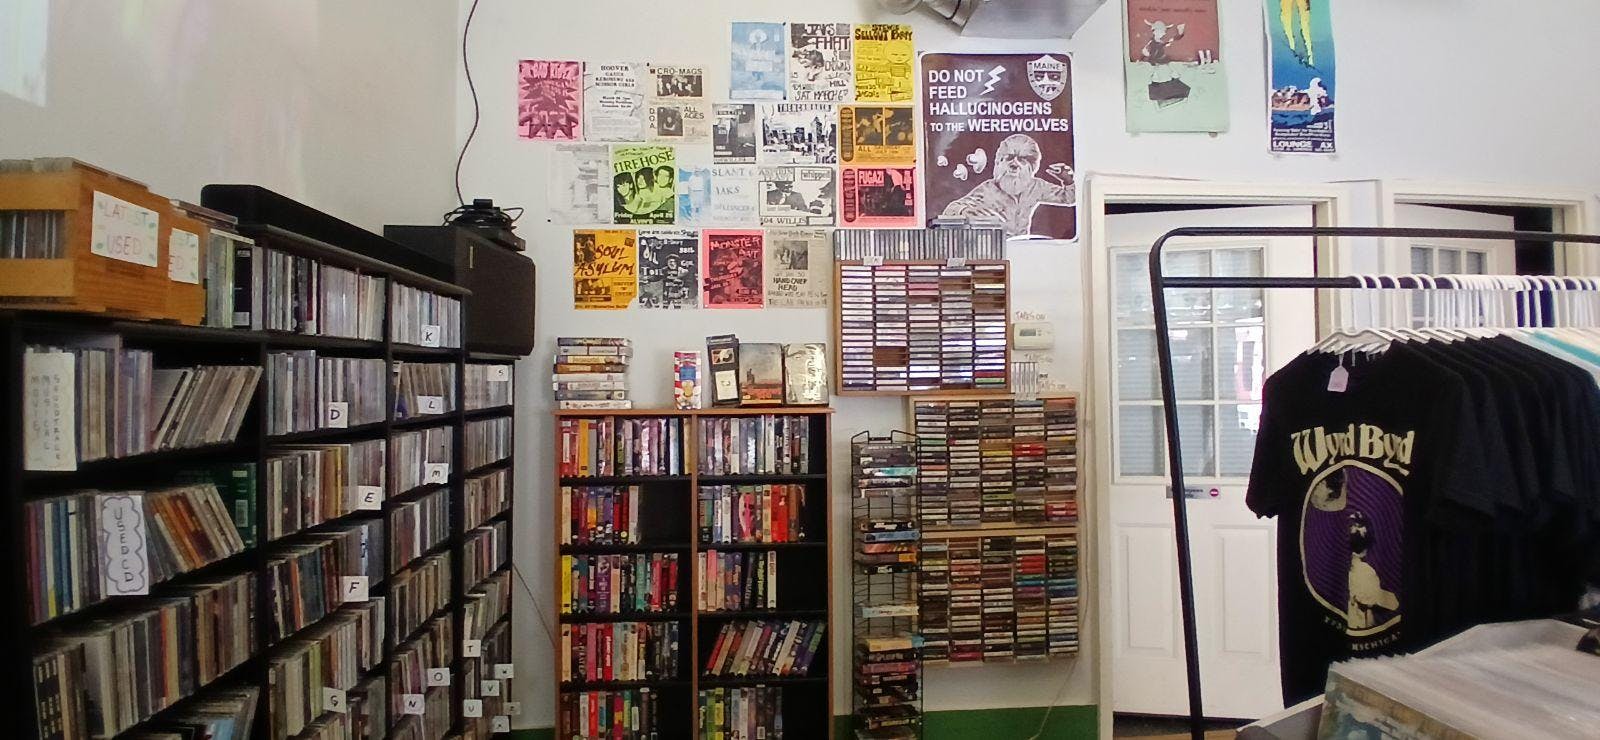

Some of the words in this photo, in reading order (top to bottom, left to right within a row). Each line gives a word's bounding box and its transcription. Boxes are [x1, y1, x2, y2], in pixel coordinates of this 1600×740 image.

[657, 67, 703, 75] CRO-MAGS
[1033, 62, 1061, 70] MAINE
[928, 69, 950, 83] DO
[954, 69, 984, 83] NOT
[929, 86, 967, 99] FEED
[929, 101, 1052, 116] HALLUCINOGENS
[684, 112, 704, 120] AGES
[930, 122, 943, 132] TO
[946, 122, 965, 132] THE
[967, 118, 1069, 132] WEREWOLVES
[1272, 140, 1312, 148] LOUNGE
[1320, 141, 1333, 149] AX
[104, 201, 149, 226] LATEST
[106, 234, 143, 256] USED
[594, 244, 629, 260] SOUL
[425, 331, 433, 342] K
[428, 400, 436, 409] L
[330, 409, 340, 420] D
[1291, 423, 1356, 475] Wyrd
[1359, 423, 1415, 477] Byrd
[364, 492, 375, 503] E
[114, 507, 129, 555] USED
[121, 559, 134, 582] CD
[349, 581, 360, 594] F
[467, 645, 474, 653] T
[434, 672, 443, 682] O
[408, 700, 417, 708] N
[468, 705, 475, 713] U
